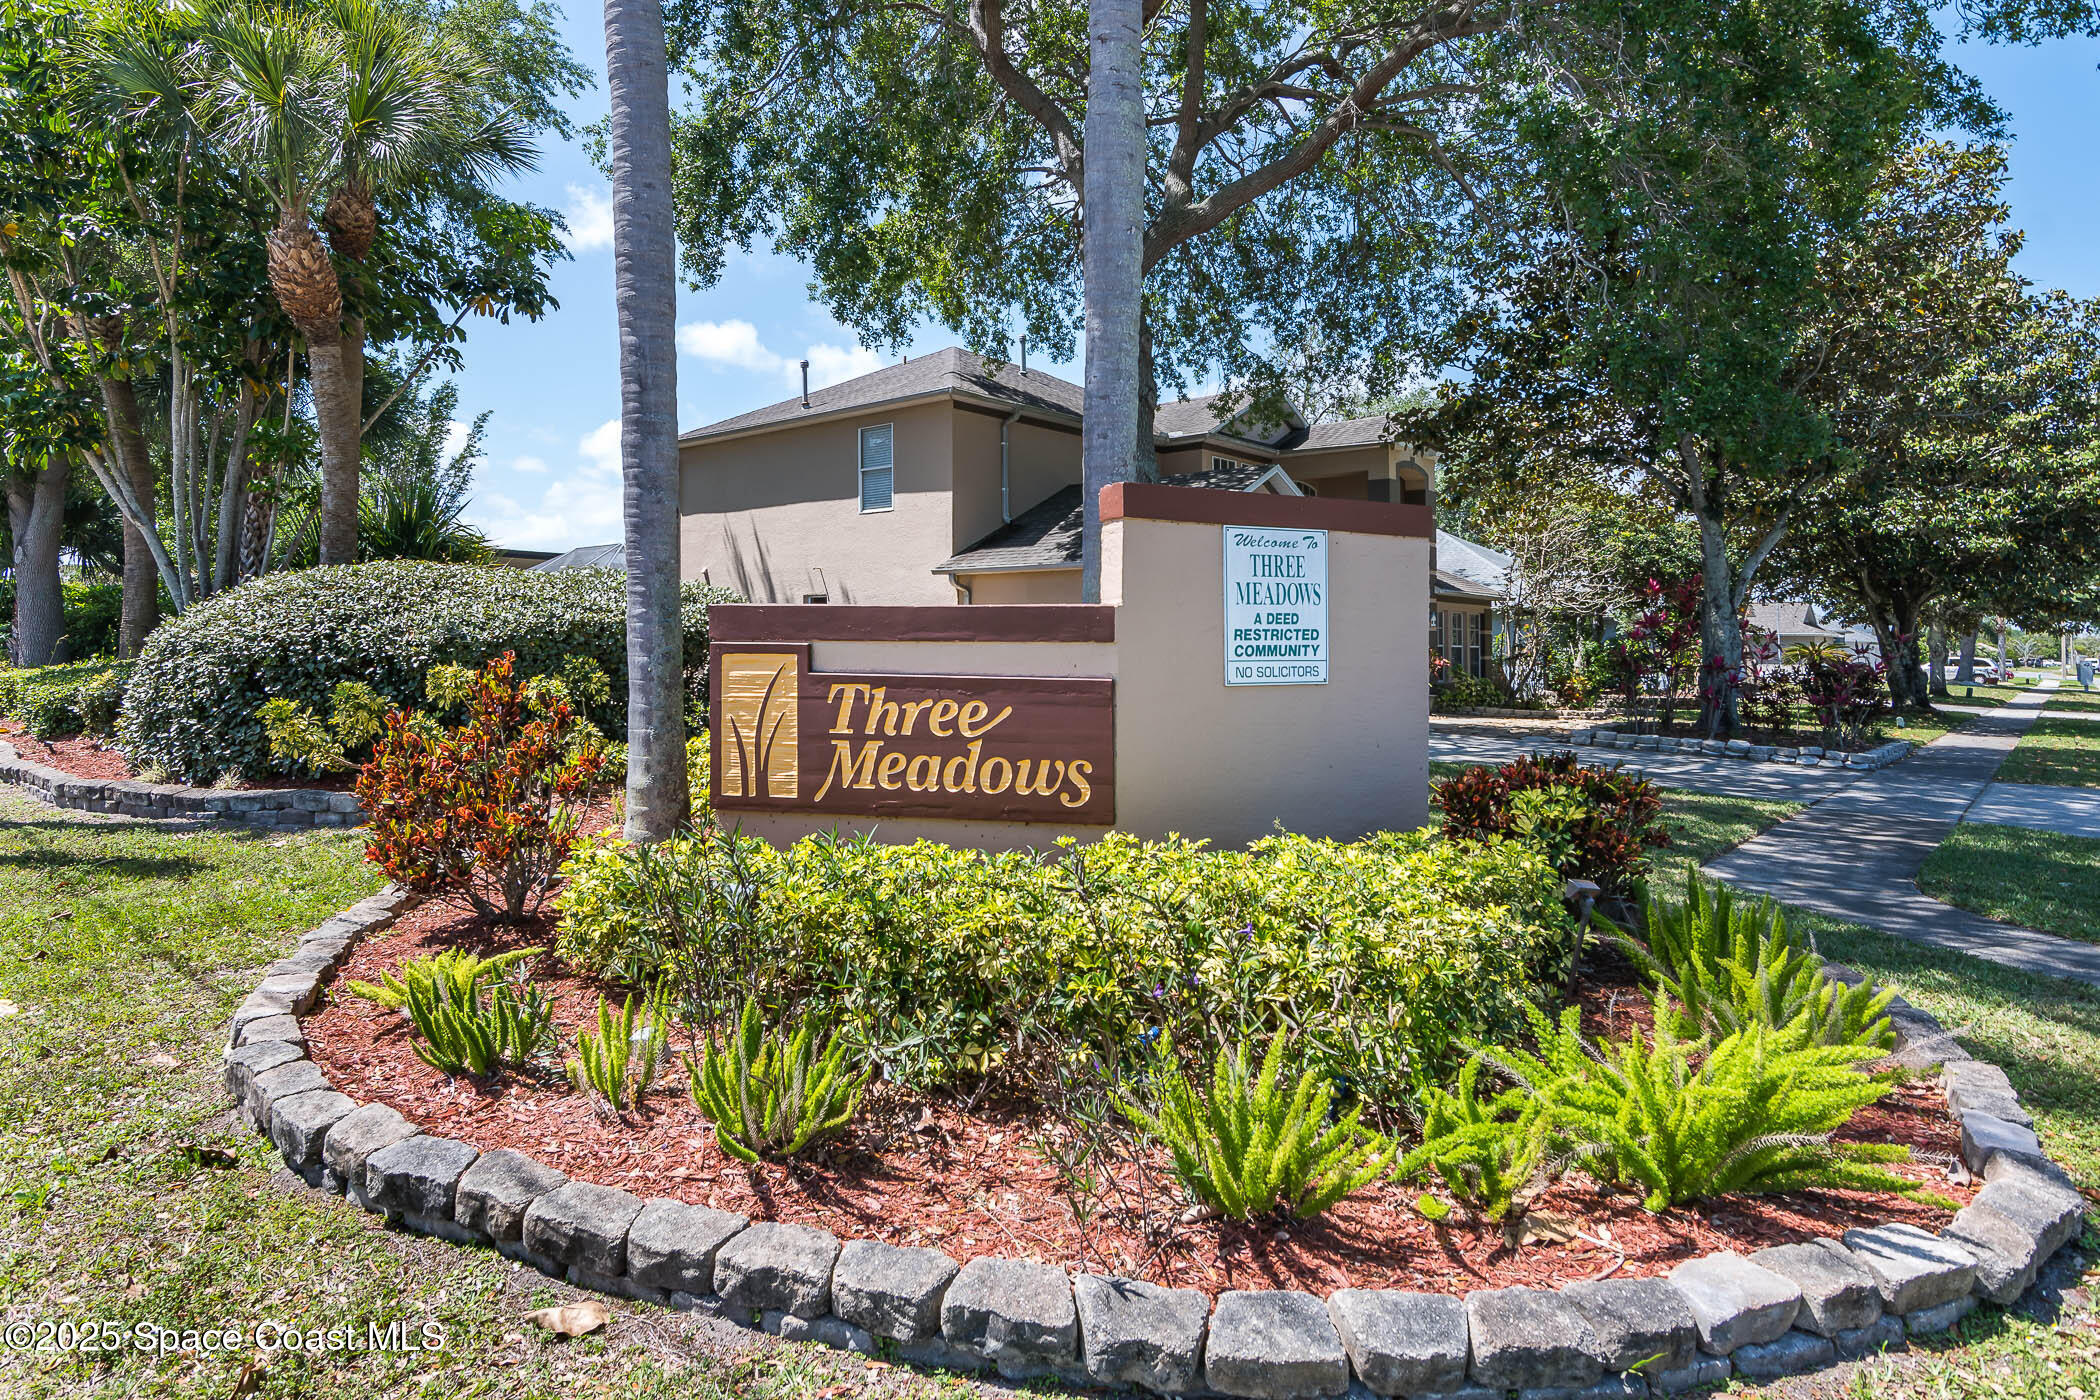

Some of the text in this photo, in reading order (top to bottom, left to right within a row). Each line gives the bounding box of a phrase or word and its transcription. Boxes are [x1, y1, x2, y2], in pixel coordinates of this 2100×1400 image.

[1234, 533, 1318, 549] Welcome To
[1250, 554, 1305, 578] THREE
[1236, 582, 1321, 605] MEADOWS
[1254, 613, 1299, 625] A DEED
[1234, 629, 1320, 641] RESTRICTED
[1234, 644, 1320, 657] COMMUNITY
[1236, 665, 1319, 678] NO SOLICITORS
[827, 683, 1013, 737] Three
[814, 739, 1093, 807] Meadows
